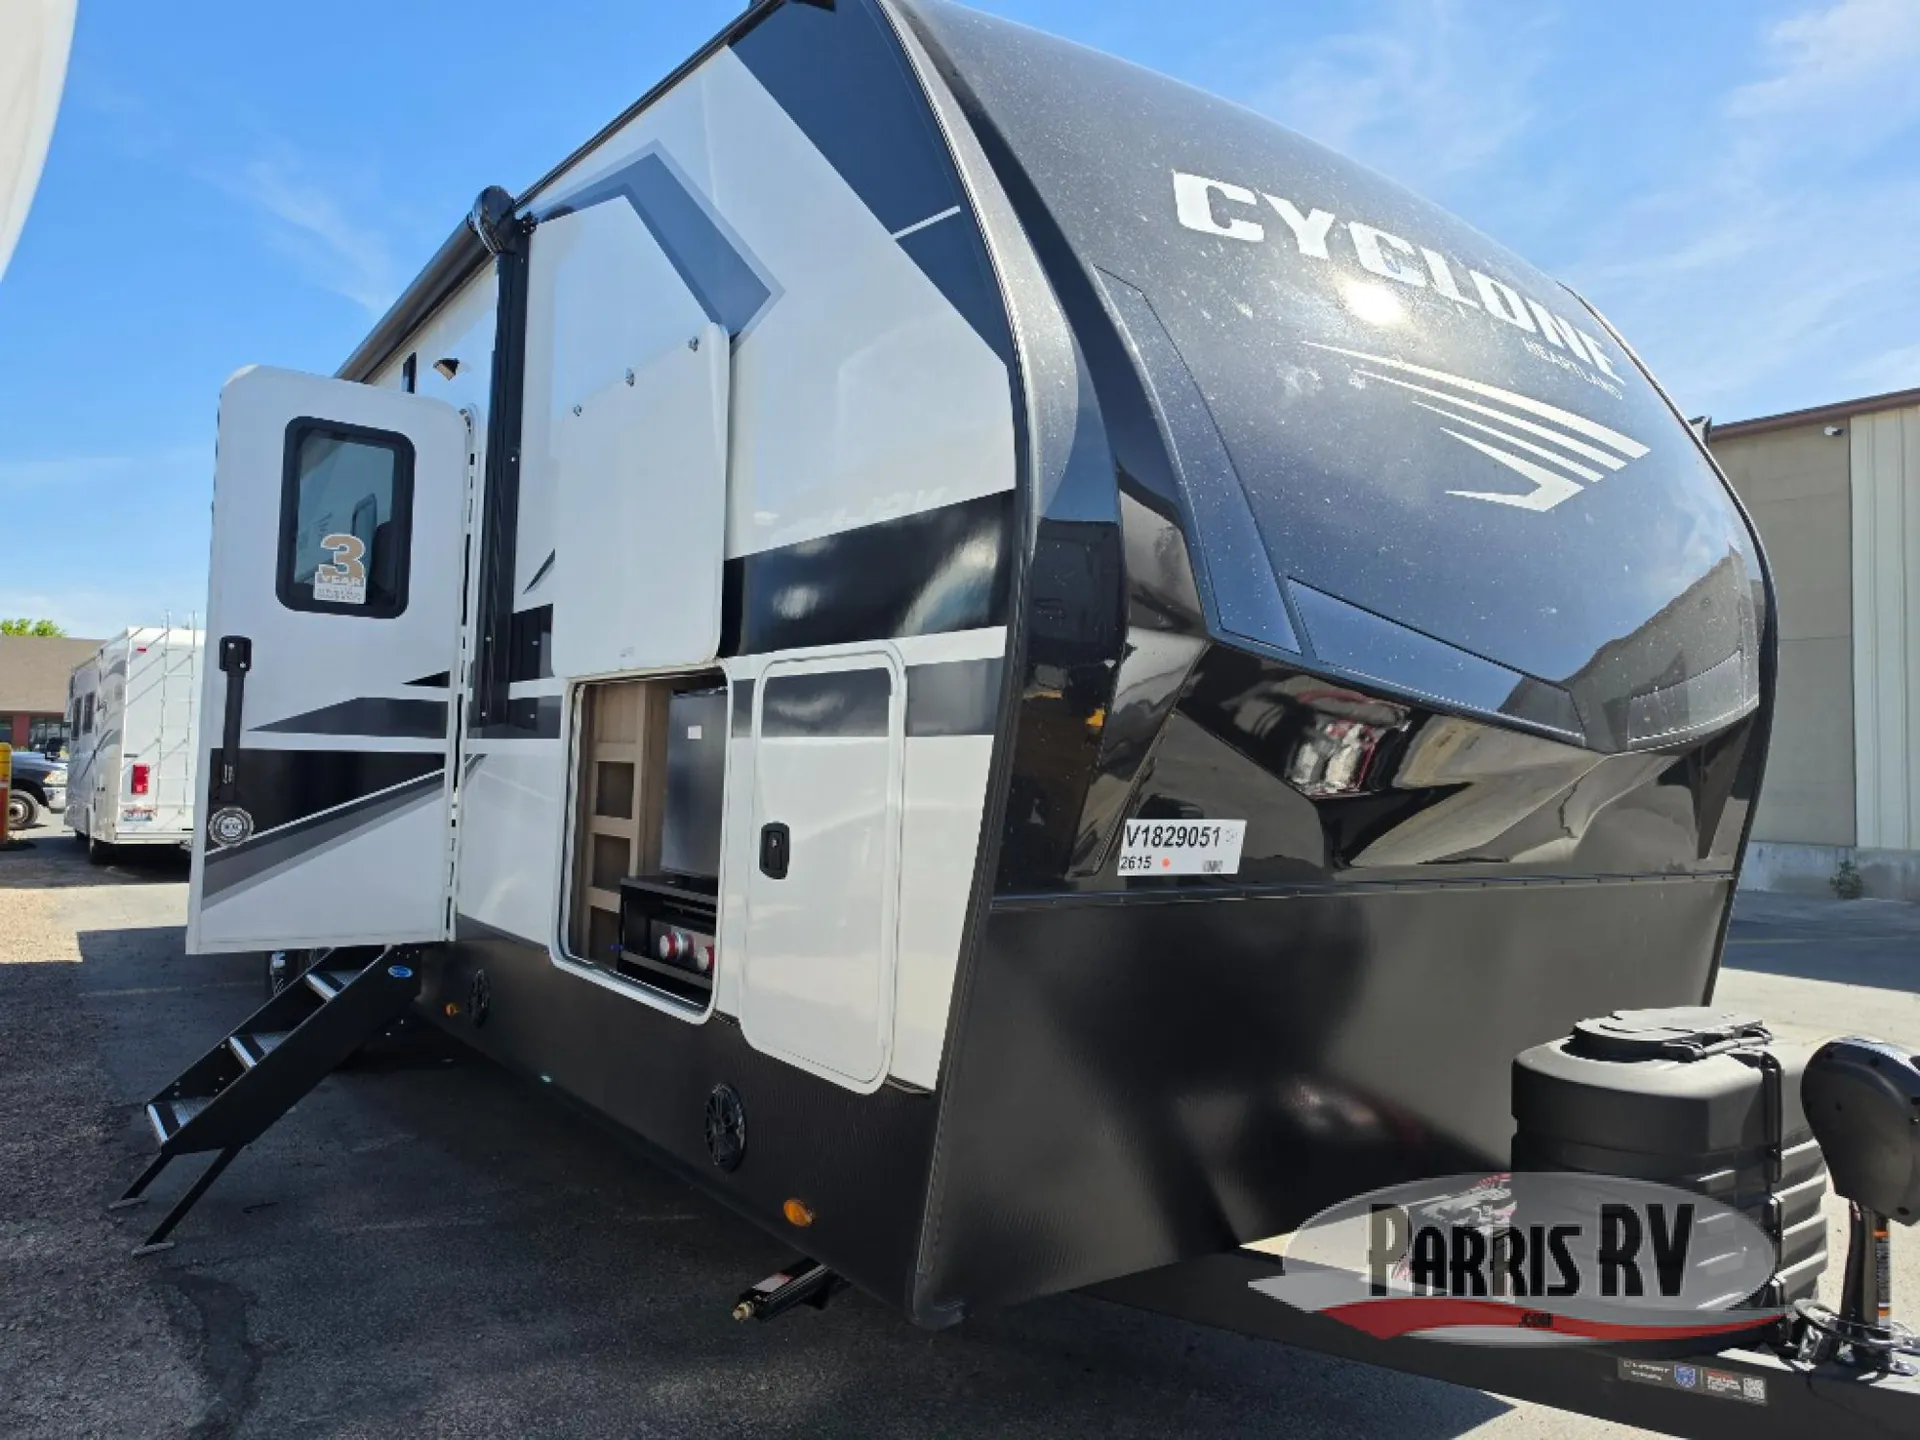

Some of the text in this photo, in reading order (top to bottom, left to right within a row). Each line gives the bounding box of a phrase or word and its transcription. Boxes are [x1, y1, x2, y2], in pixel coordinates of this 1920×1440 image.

[1172, 170, 1625, 385] CYCLONE
[319, 534, 366, 584] 3
[1126, 824, 1221, 848] V1829051
[1120, 856, 1152, 870] 2615
